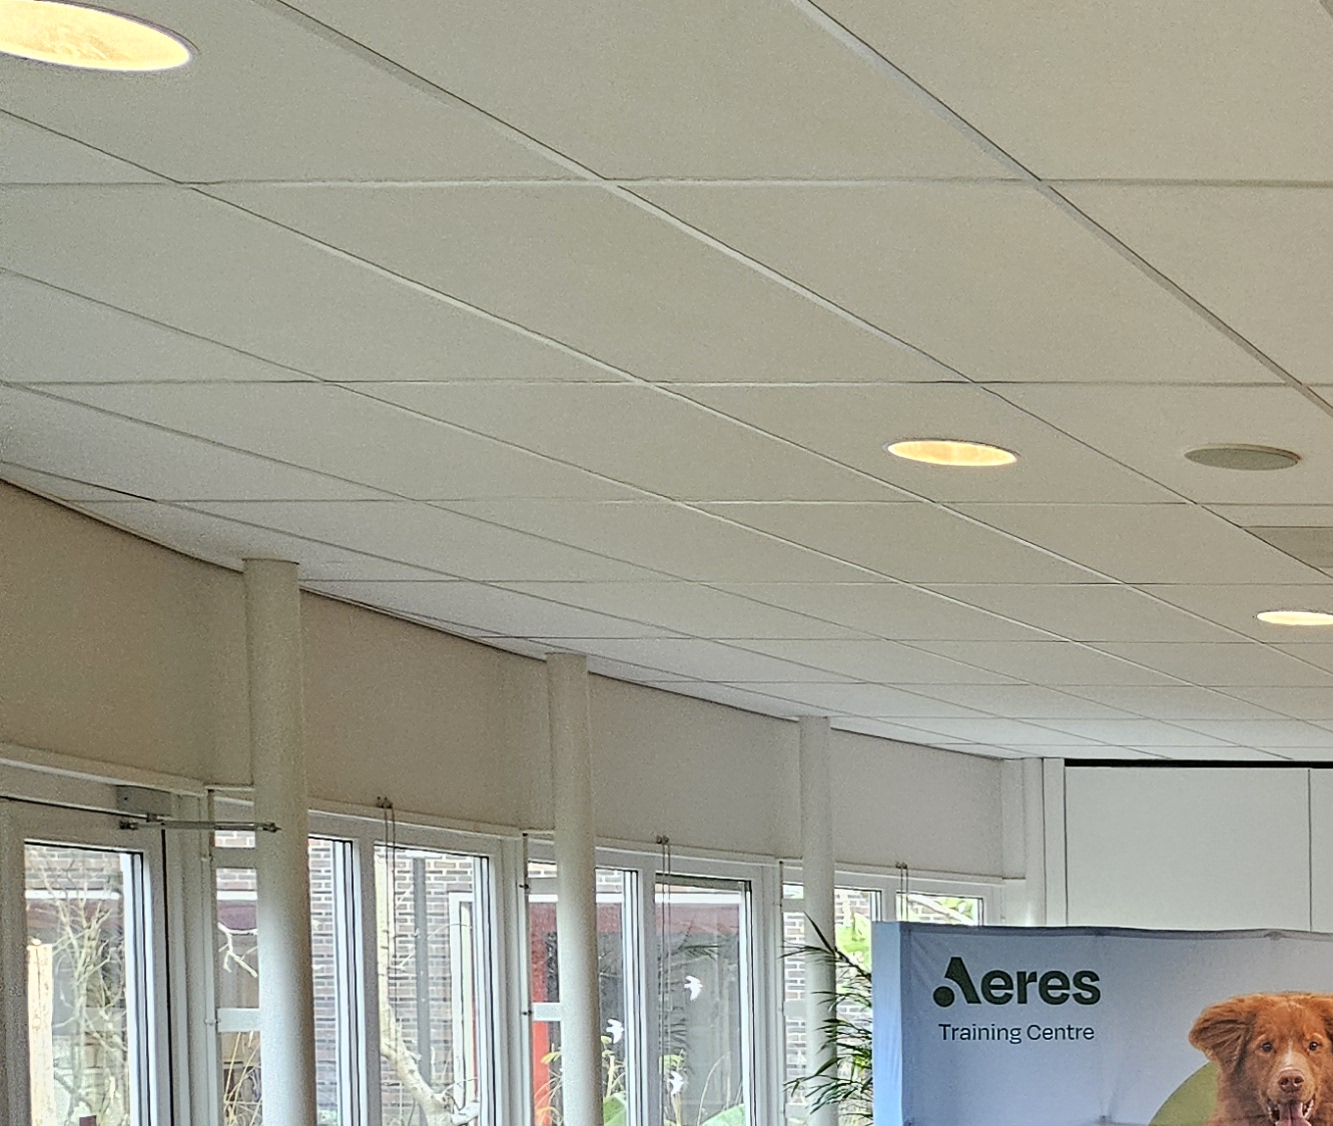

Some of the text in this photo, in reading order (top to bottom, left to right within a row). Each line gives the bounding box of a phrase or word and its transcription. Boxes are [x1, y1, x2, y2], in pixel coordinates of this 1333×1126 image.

[933, 957, 1101, 1007] Aeres
[938, 1024, 1094, 1044] Training Centre
